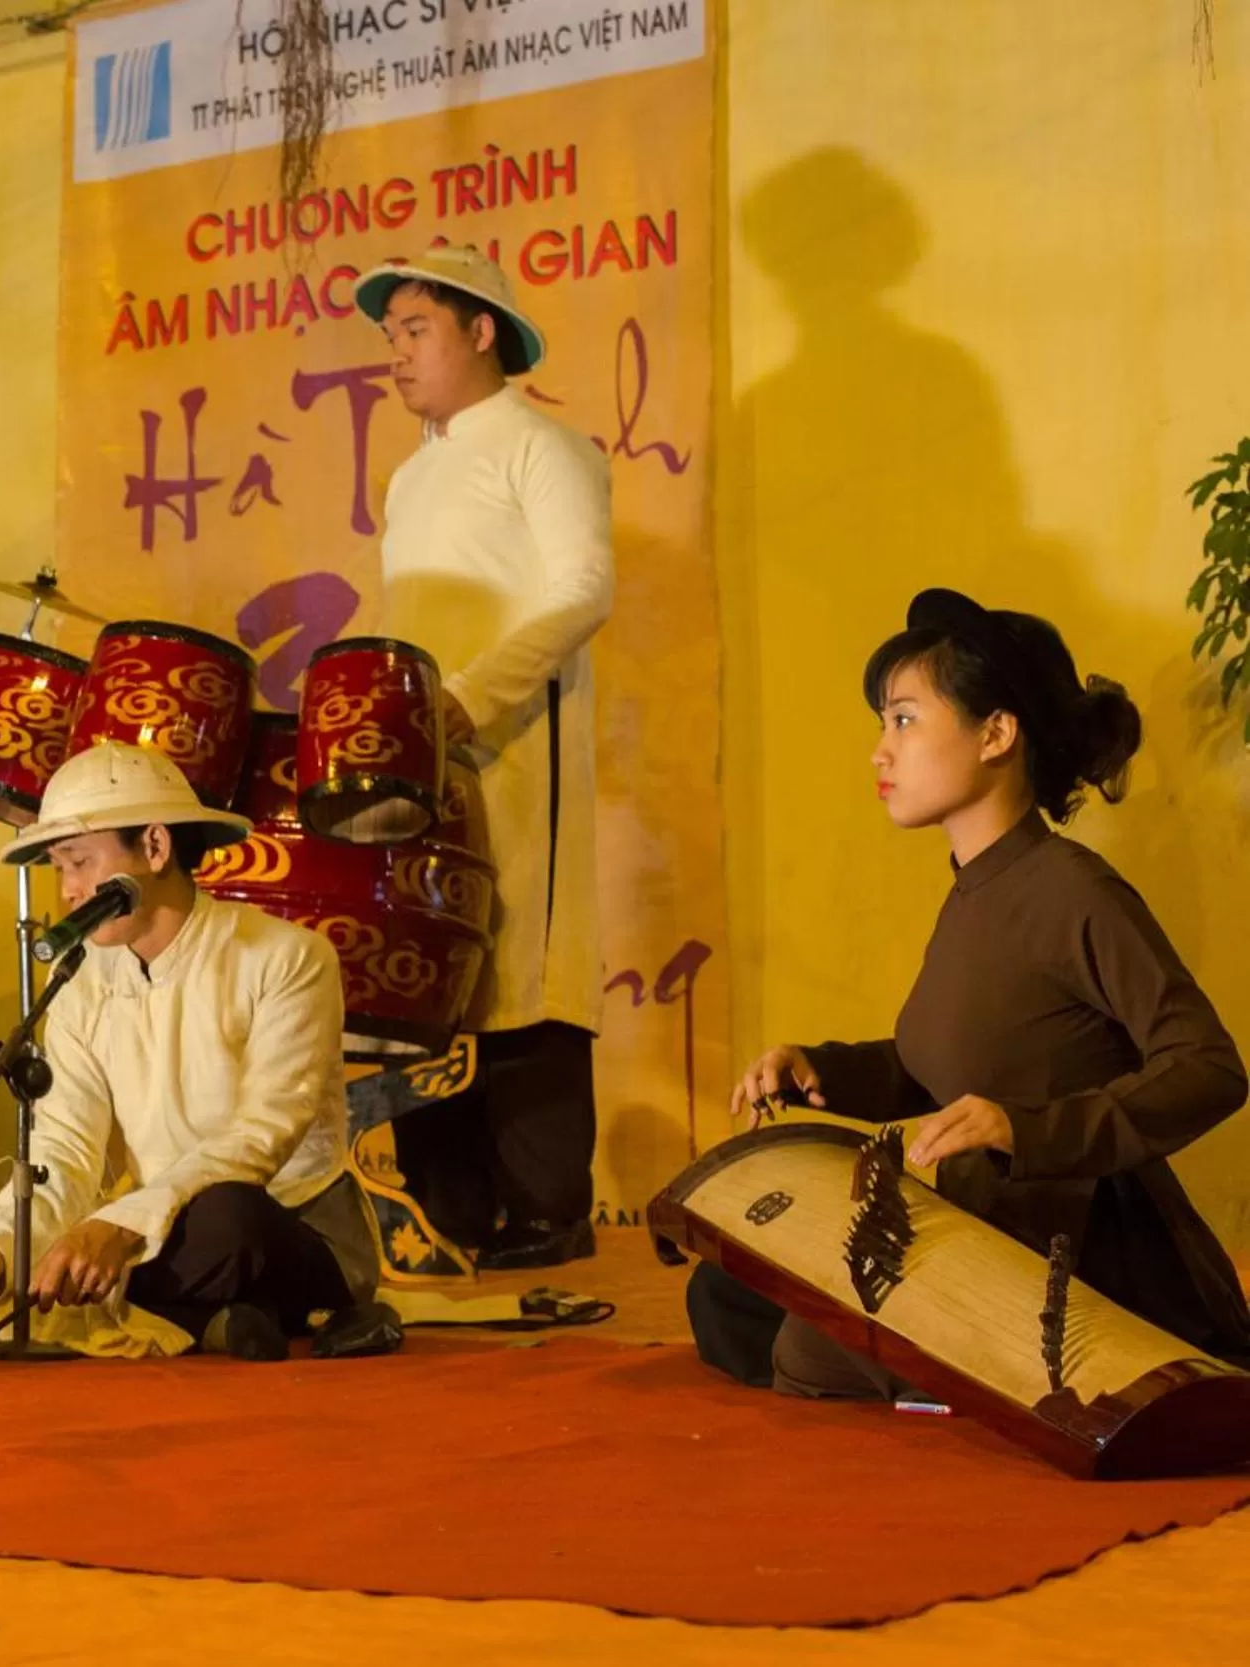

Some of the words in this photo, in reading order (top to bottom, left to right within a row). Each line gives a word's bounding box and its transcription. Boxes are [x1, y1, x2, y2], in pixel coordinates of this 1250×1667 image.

[392, 45, 456, 90] THUẬT
[461, 39, 498, 75] ÂM
[504, 25, 573, 67] NHẠC
[578, 8, 624, 52] VIỆT
[631, 2, 689, 40] NAM
[432, 143, 579, 220] TRÌNH
[105, 289, 190, 356] ÂM
[205, 263, 362, 340] NHẠC
[518, 210, 678, 287] GIAN
[124, 386, 293, 552] Hà
